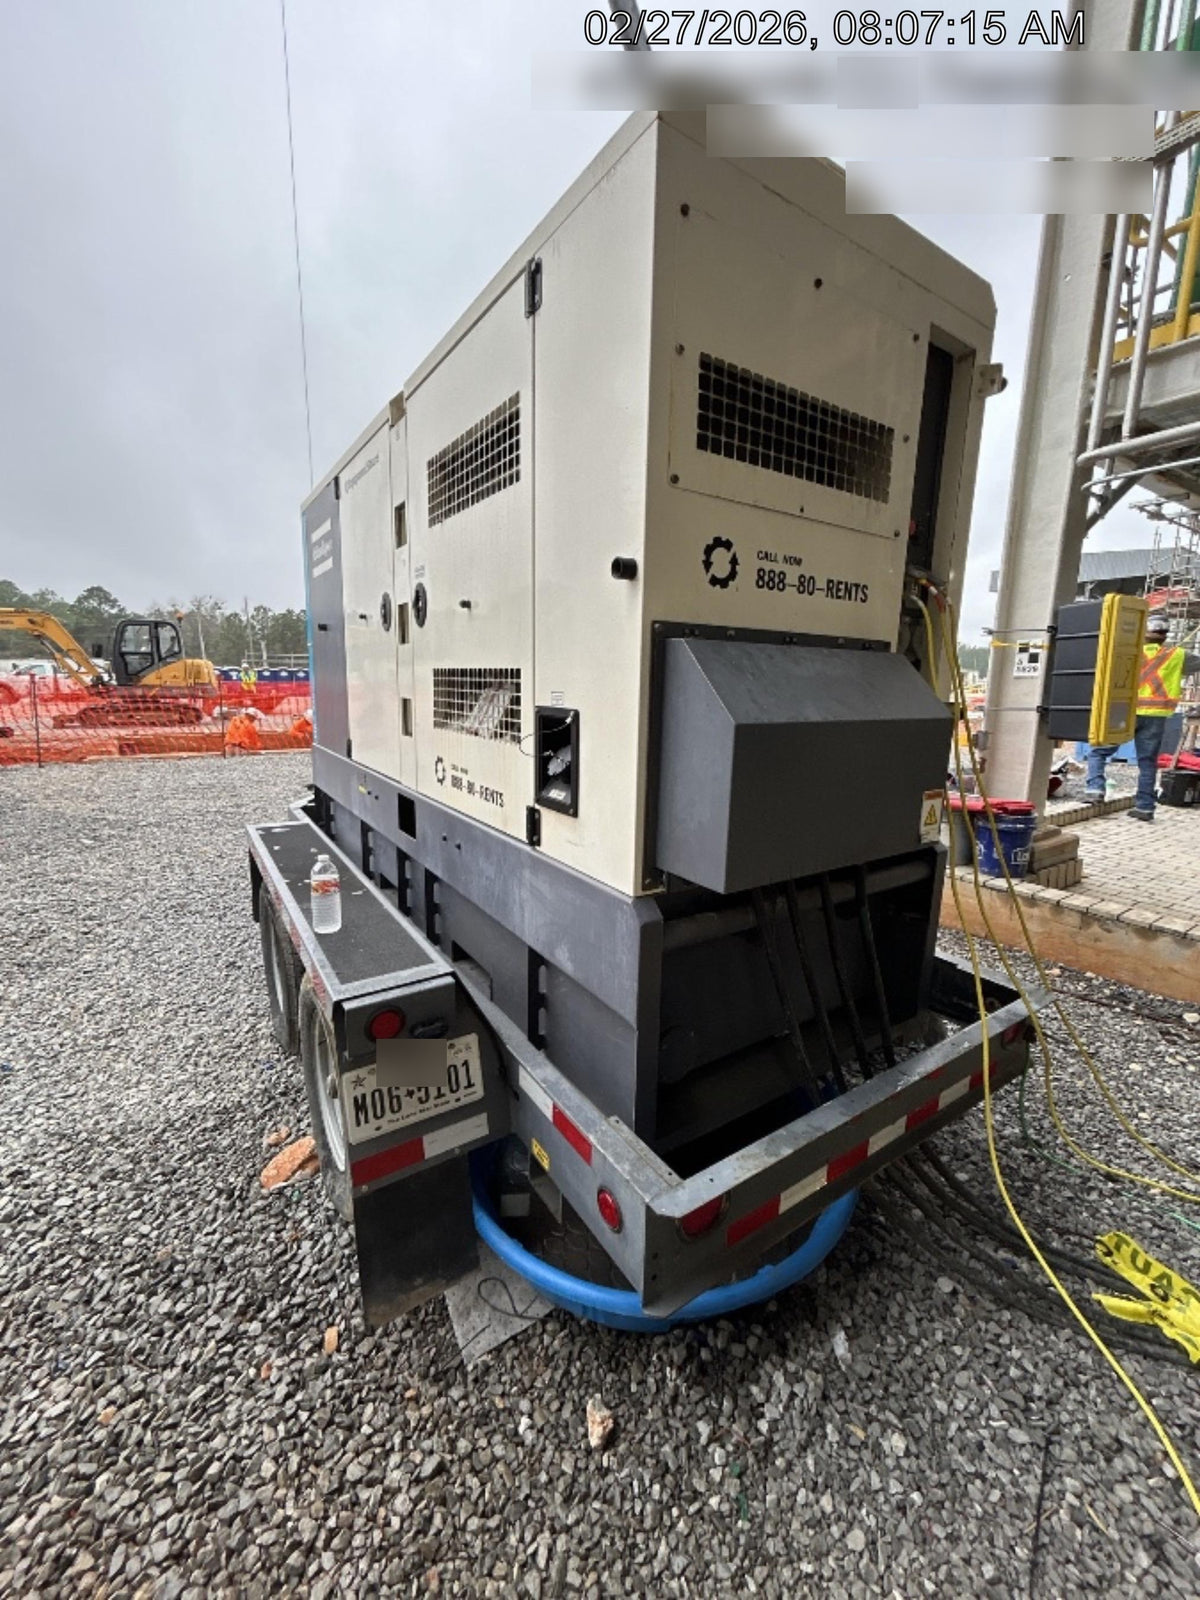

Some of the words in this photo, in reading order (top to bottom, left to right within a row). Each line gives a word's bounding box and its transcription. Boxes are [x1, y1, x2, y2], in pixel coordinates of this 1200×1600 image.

[757, 551, 779, 564] CALL
[782, 555, 802, 567] NOW
[755, 567, 869, 604] 888-80-RENTS
